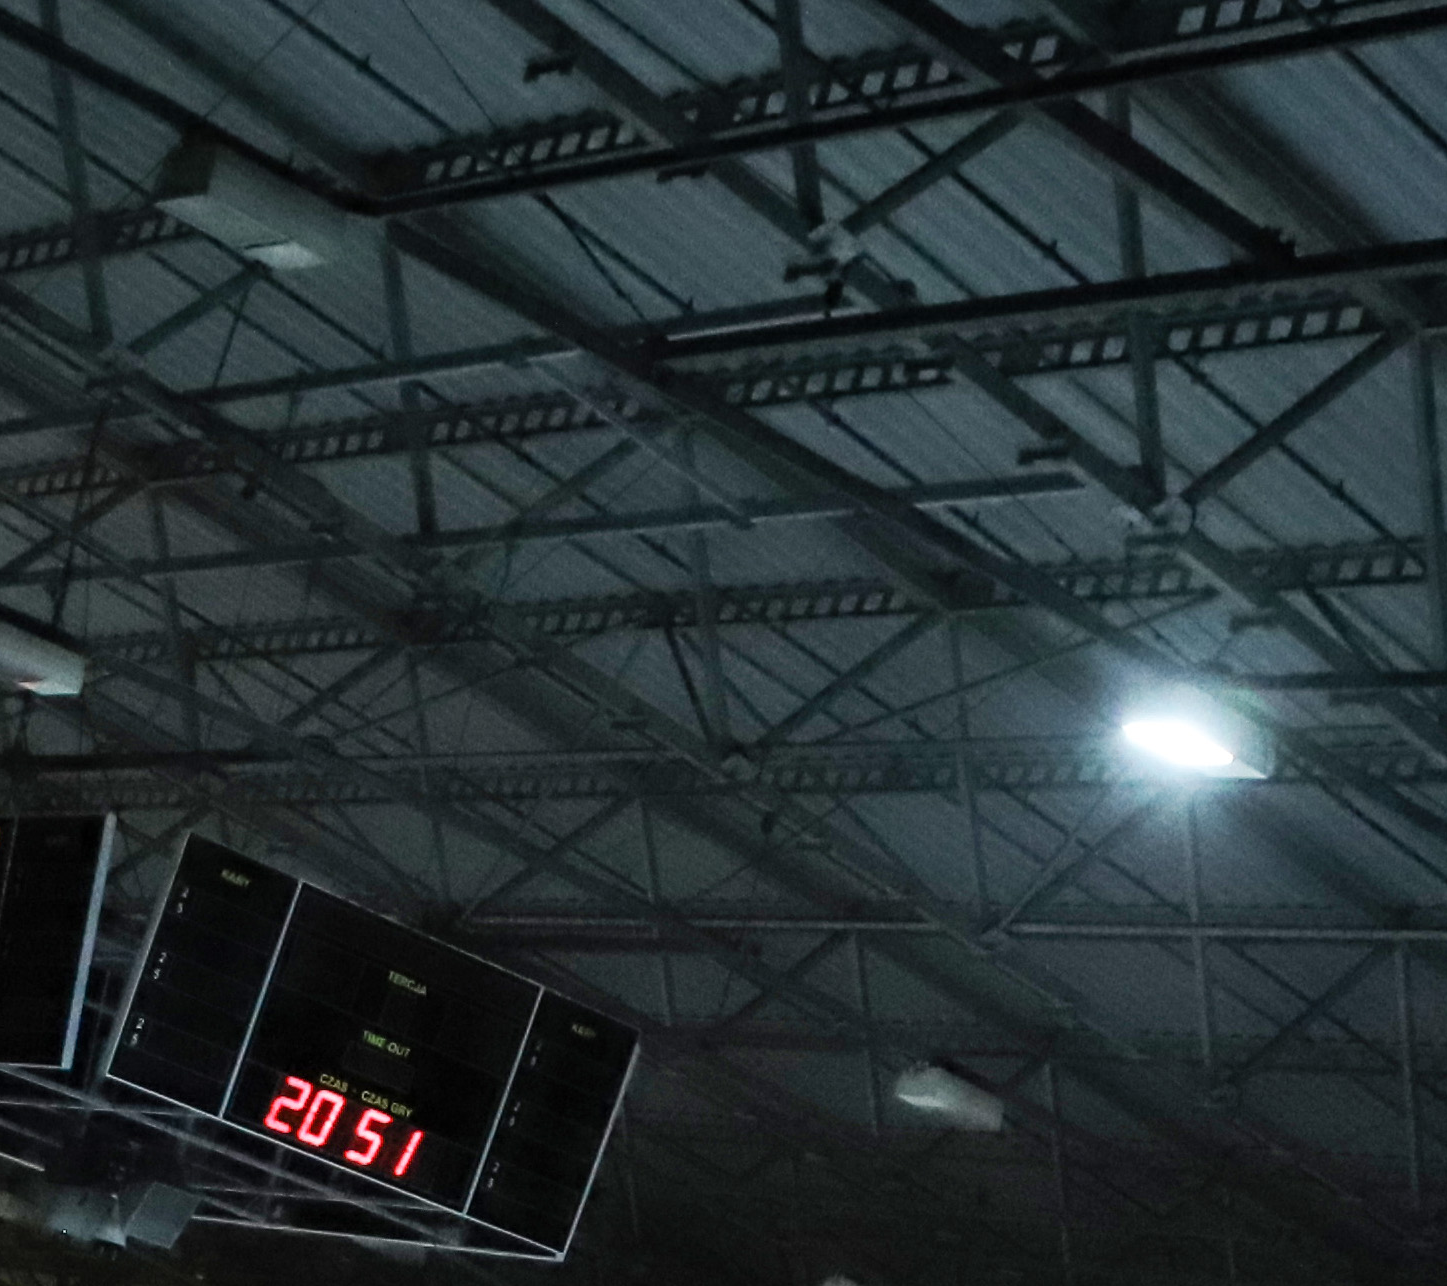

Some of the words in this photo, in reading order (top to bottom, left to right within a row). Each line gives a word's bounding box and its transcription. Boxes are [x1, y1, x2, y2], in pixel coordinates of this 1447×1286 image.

[388, 1042, 411, 1058] OUT
[320, 1073, 348, 1093] CZAS
[361, 1090, 389, 1110] CZAS
